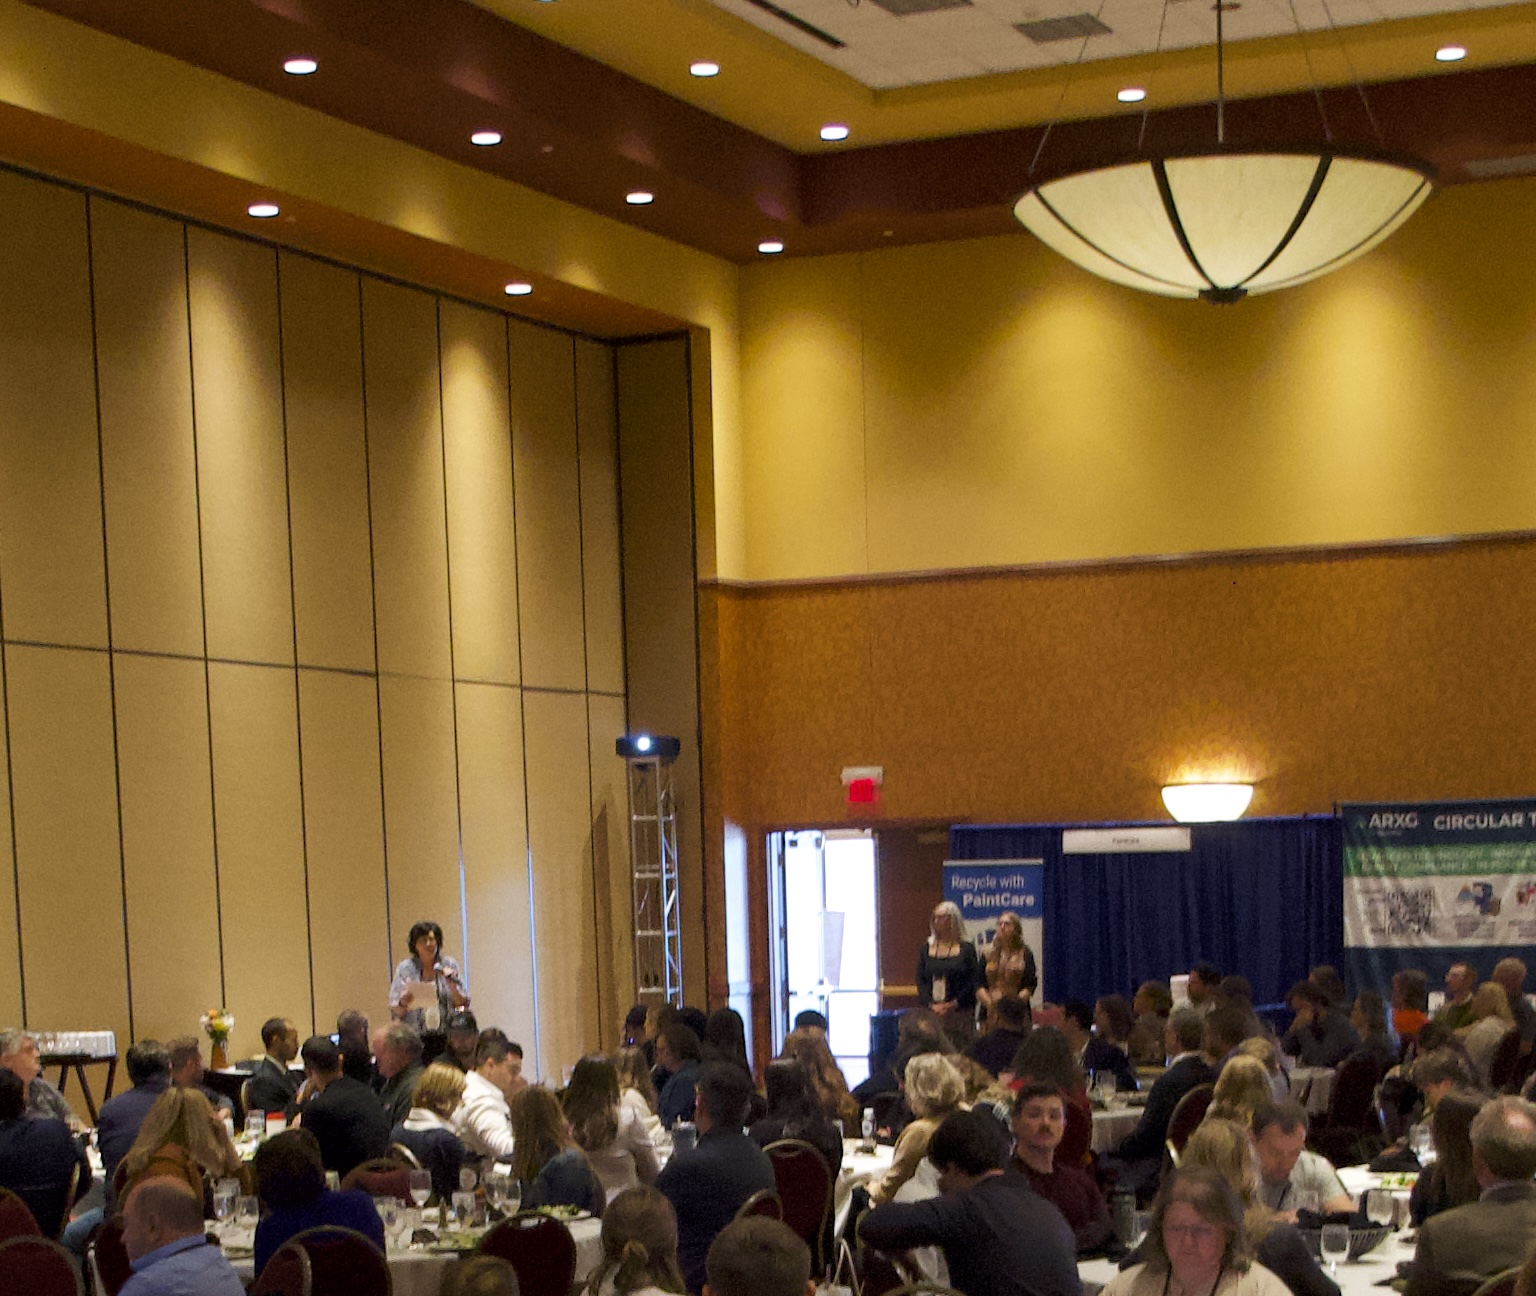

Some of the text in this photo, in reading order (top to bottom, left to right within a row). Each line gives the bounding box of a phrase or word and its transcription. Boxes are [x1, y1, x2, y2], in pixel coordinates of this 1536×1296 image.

[1433, 811, 1525, 831] CIRCULAR
[951, 874, 1025, 891] Recycle with
[962, 892, 1035, 908] PaintCare
